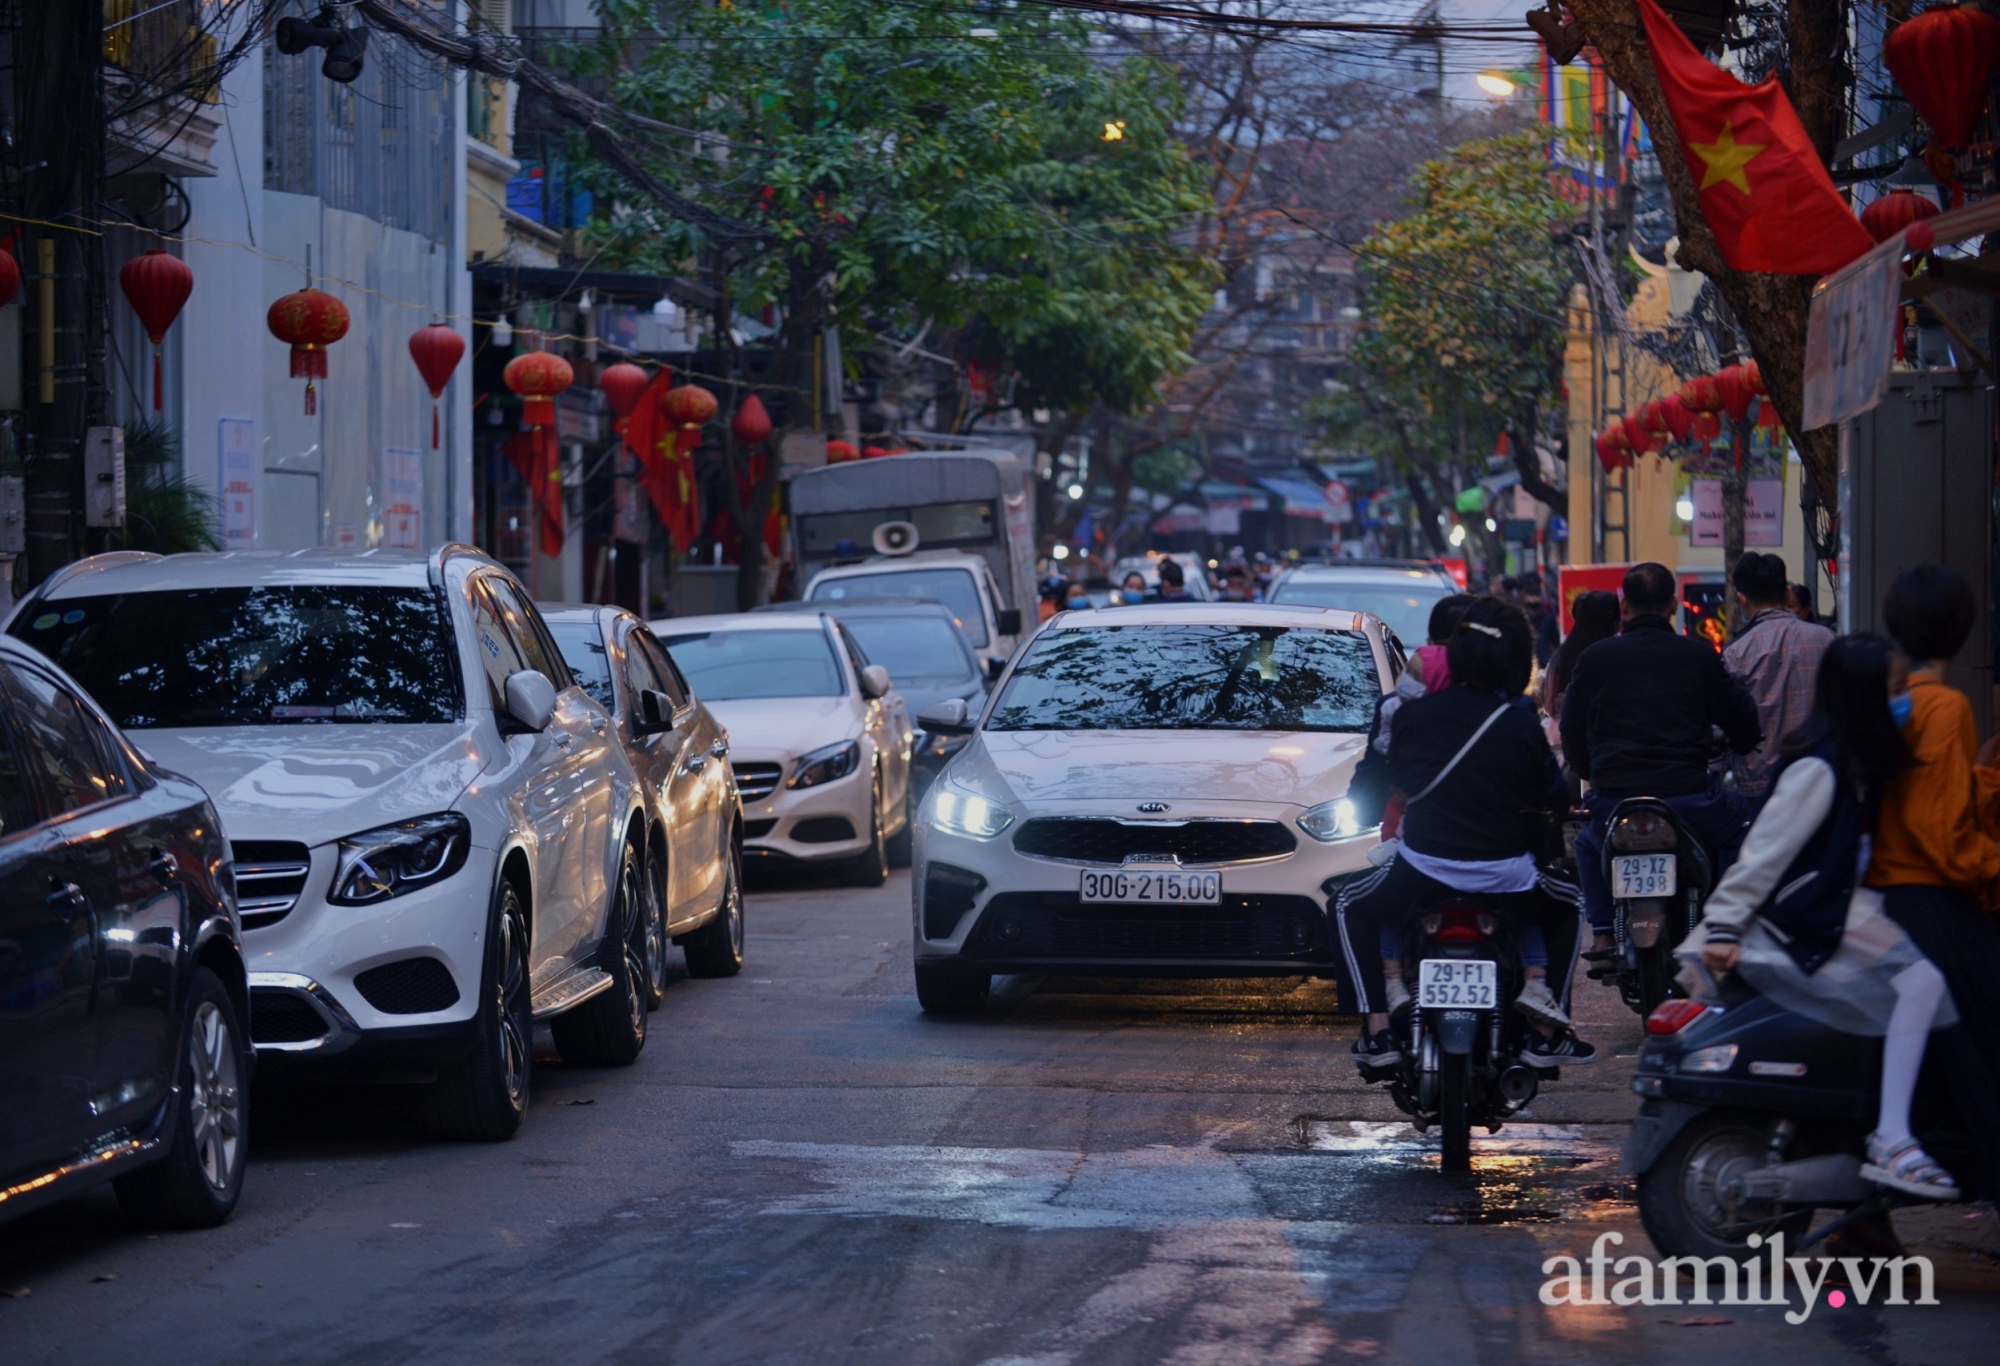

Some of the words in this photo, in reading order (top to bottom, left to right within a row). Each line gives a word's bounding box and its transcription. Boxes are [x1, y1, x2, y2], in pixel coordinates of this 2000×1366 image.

[1085, 873, 1217, 900] 30G-215.00
[1622, 875, 1667, 895] 7398
[1432, 963, 1483, 983] 29-F1
[1425, 984, 1490, 1005] 552.52
